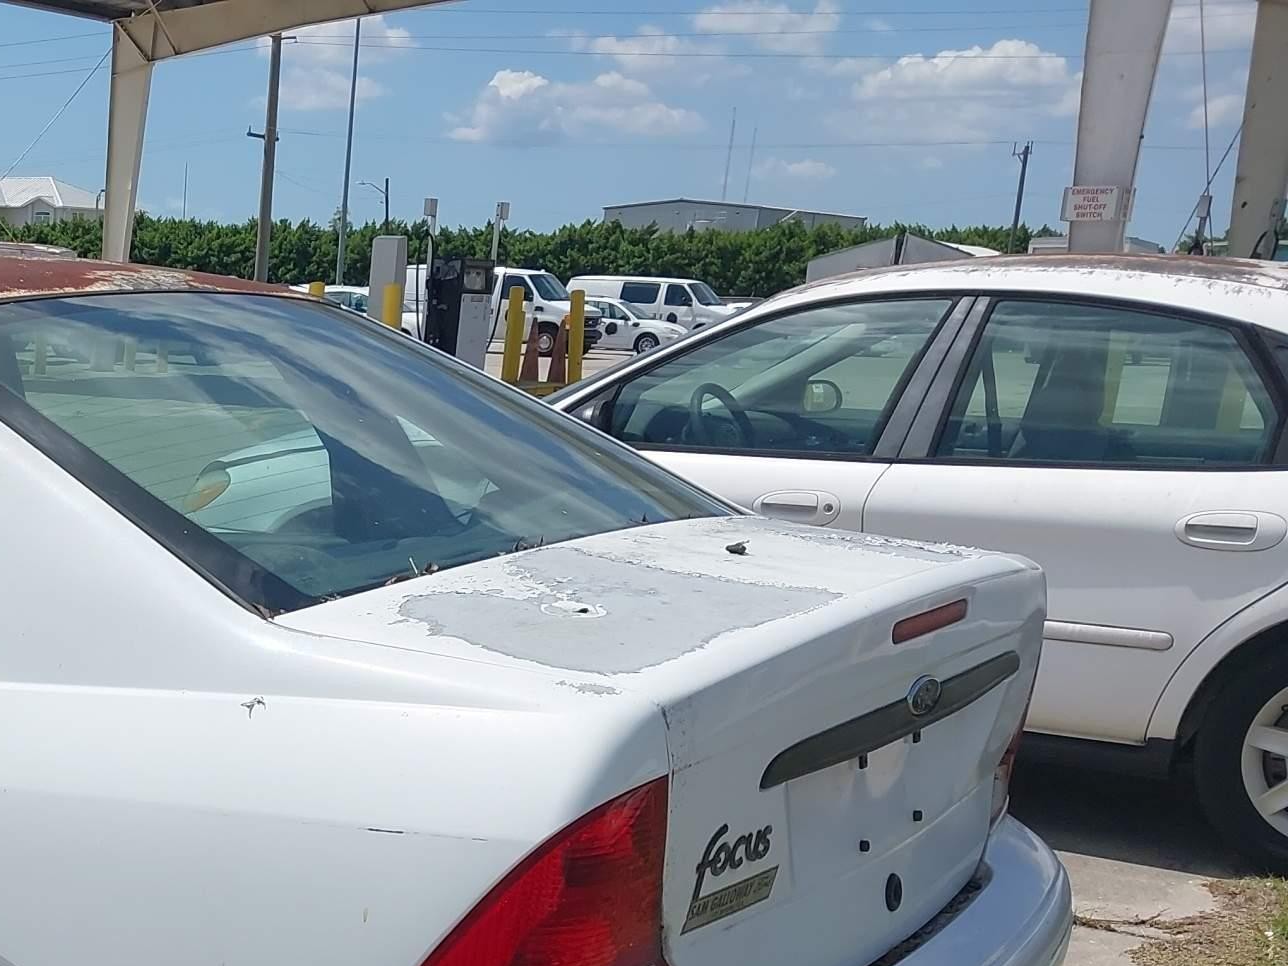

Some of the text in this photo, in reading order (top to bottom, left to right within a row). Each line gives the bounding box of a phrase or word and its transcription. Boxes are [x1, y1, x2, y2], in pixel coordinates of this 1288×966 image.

[1072, 187, 1114, 195] EMERGENCY
[1083, 195, 1100, 203] FUEL
[1073, 203, 1107, 211] SHUT-OFF
[1075, 211, 1103, 219] SWITCH
